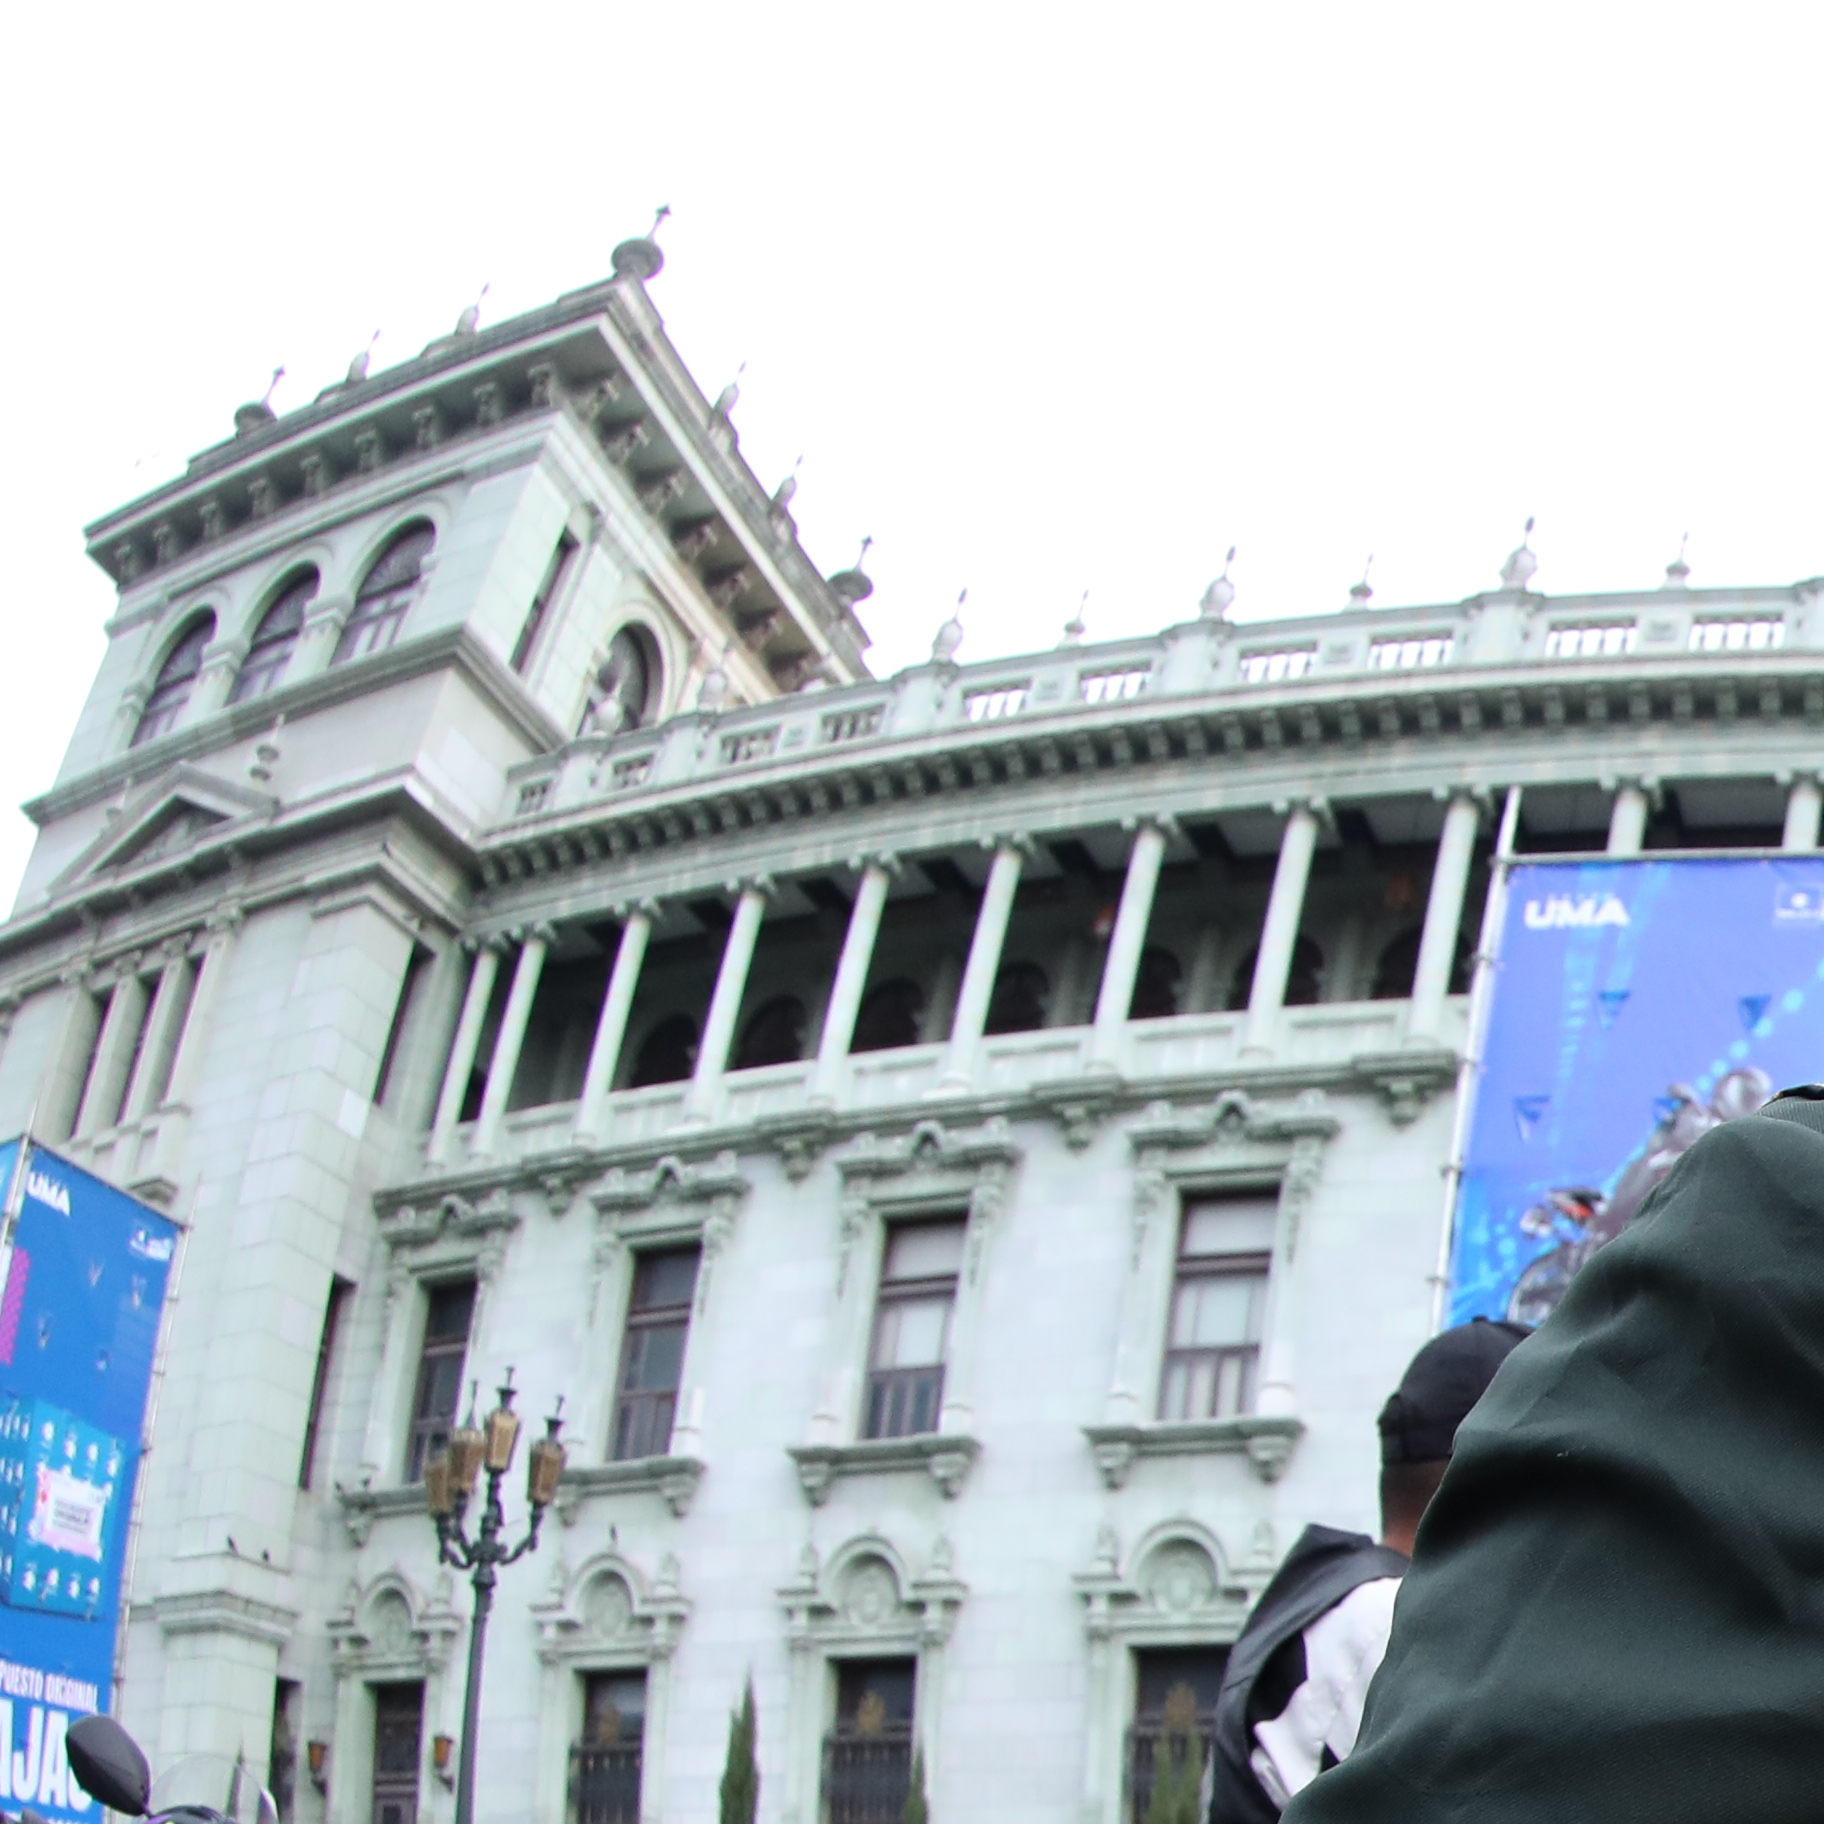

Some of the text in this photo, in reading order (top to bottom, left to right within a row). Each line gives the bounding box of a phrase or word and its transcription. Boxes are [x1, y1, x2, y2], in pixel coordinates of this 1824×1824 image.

[1524, 895, 1631, 930] UMA
[26, 1171, 71, 1217] UMA
[45, 1673, 98, 1714] ORIGINAL
